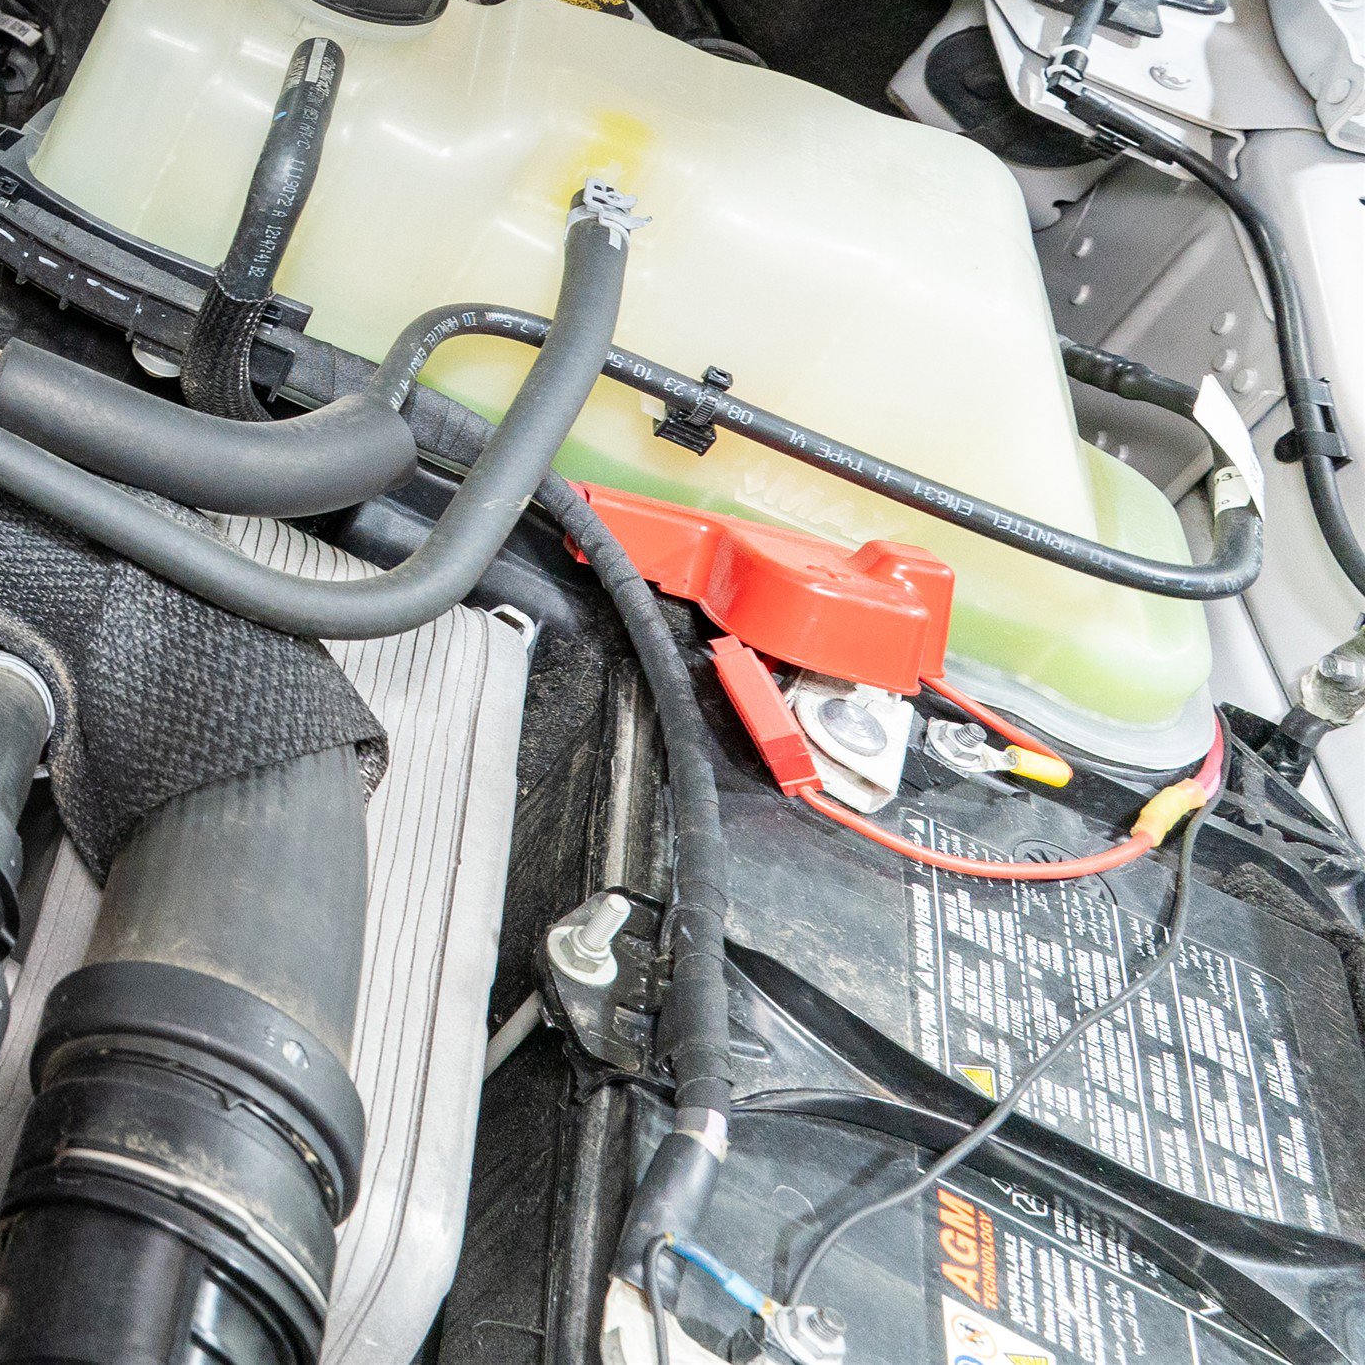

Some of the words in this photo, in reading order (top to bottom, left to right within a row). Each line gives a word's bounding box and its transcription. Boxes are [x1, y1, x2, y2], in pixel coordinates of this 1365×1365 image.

[1264, 1062, 1280, 1082] LAS
[1268, 1079, 1284, 1099] LEA
[937, 1188, 981, 1303] AGM
[978, 1210, 999, 1310] TECHNOLOGY
[1004, 1231, 1022, 1325] NON-SPILLABLE
